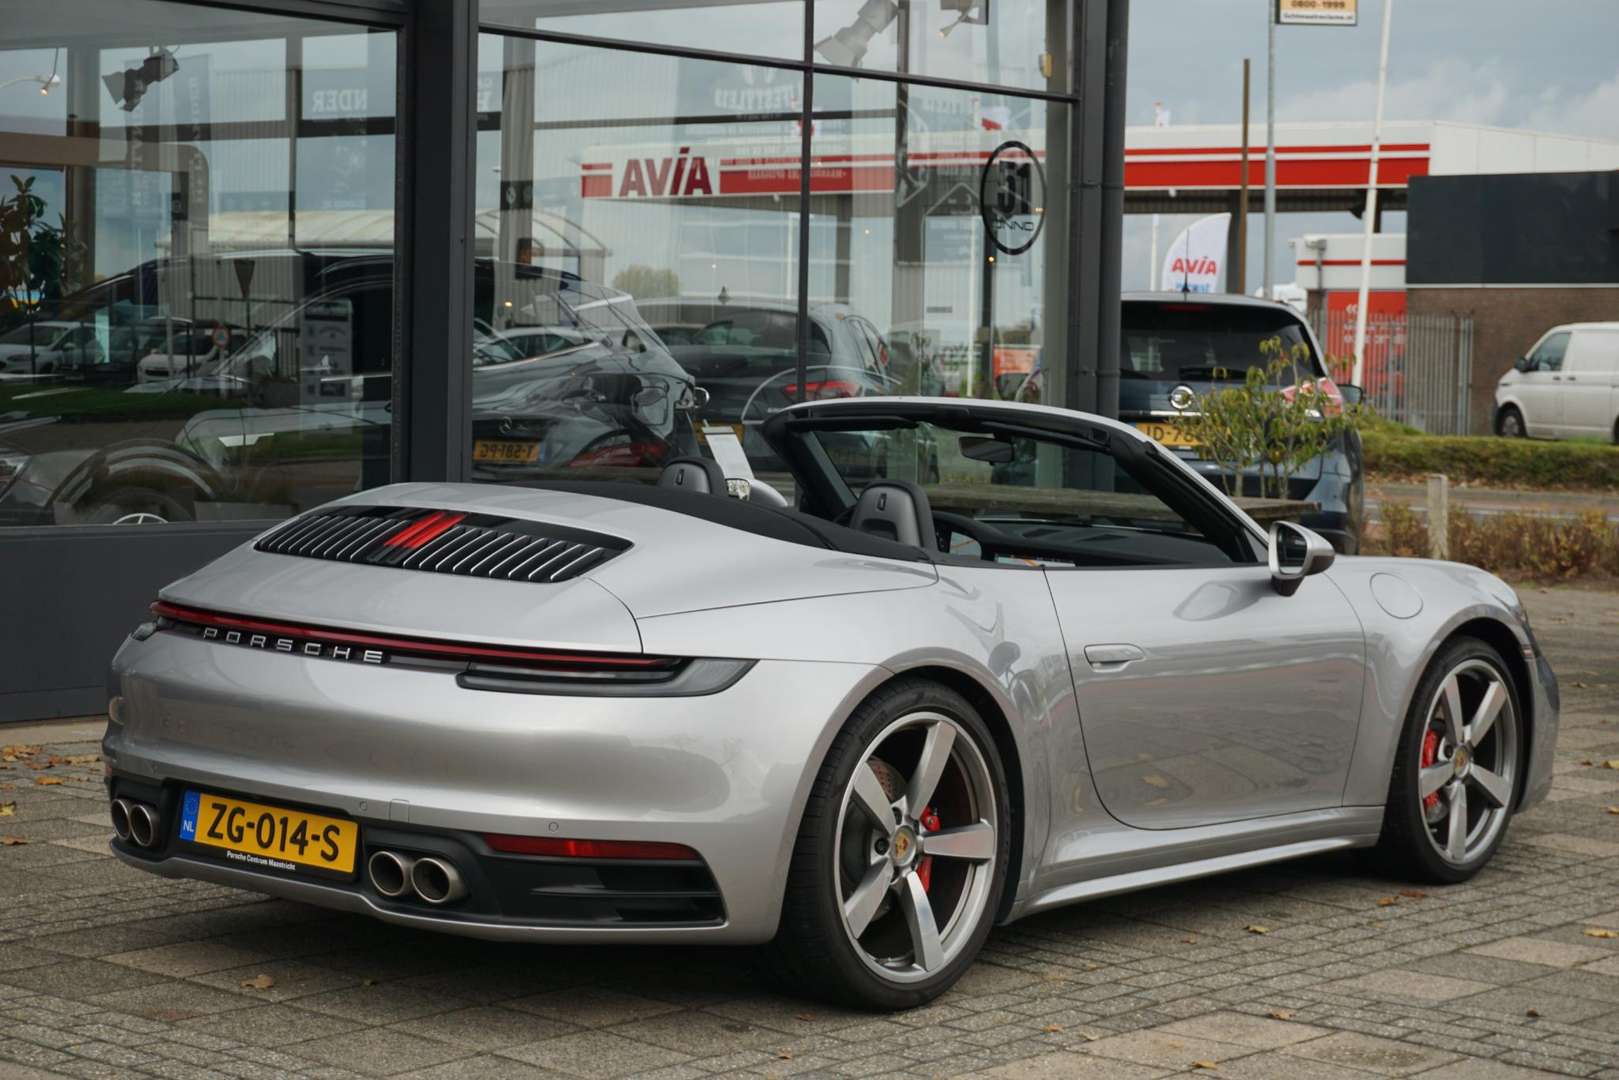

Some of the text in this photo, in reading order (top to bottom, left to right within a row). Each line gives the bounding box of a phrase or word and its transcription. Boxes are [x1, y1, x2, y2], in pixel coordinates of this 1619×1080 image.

[203, 627, 383, 664] PORSCHE
[183, 819, 195, 833] NL
[207, 802, 341, 862] ZG-014-S
[226, 850, 297, 871] Porsche Centrum Maastricht
